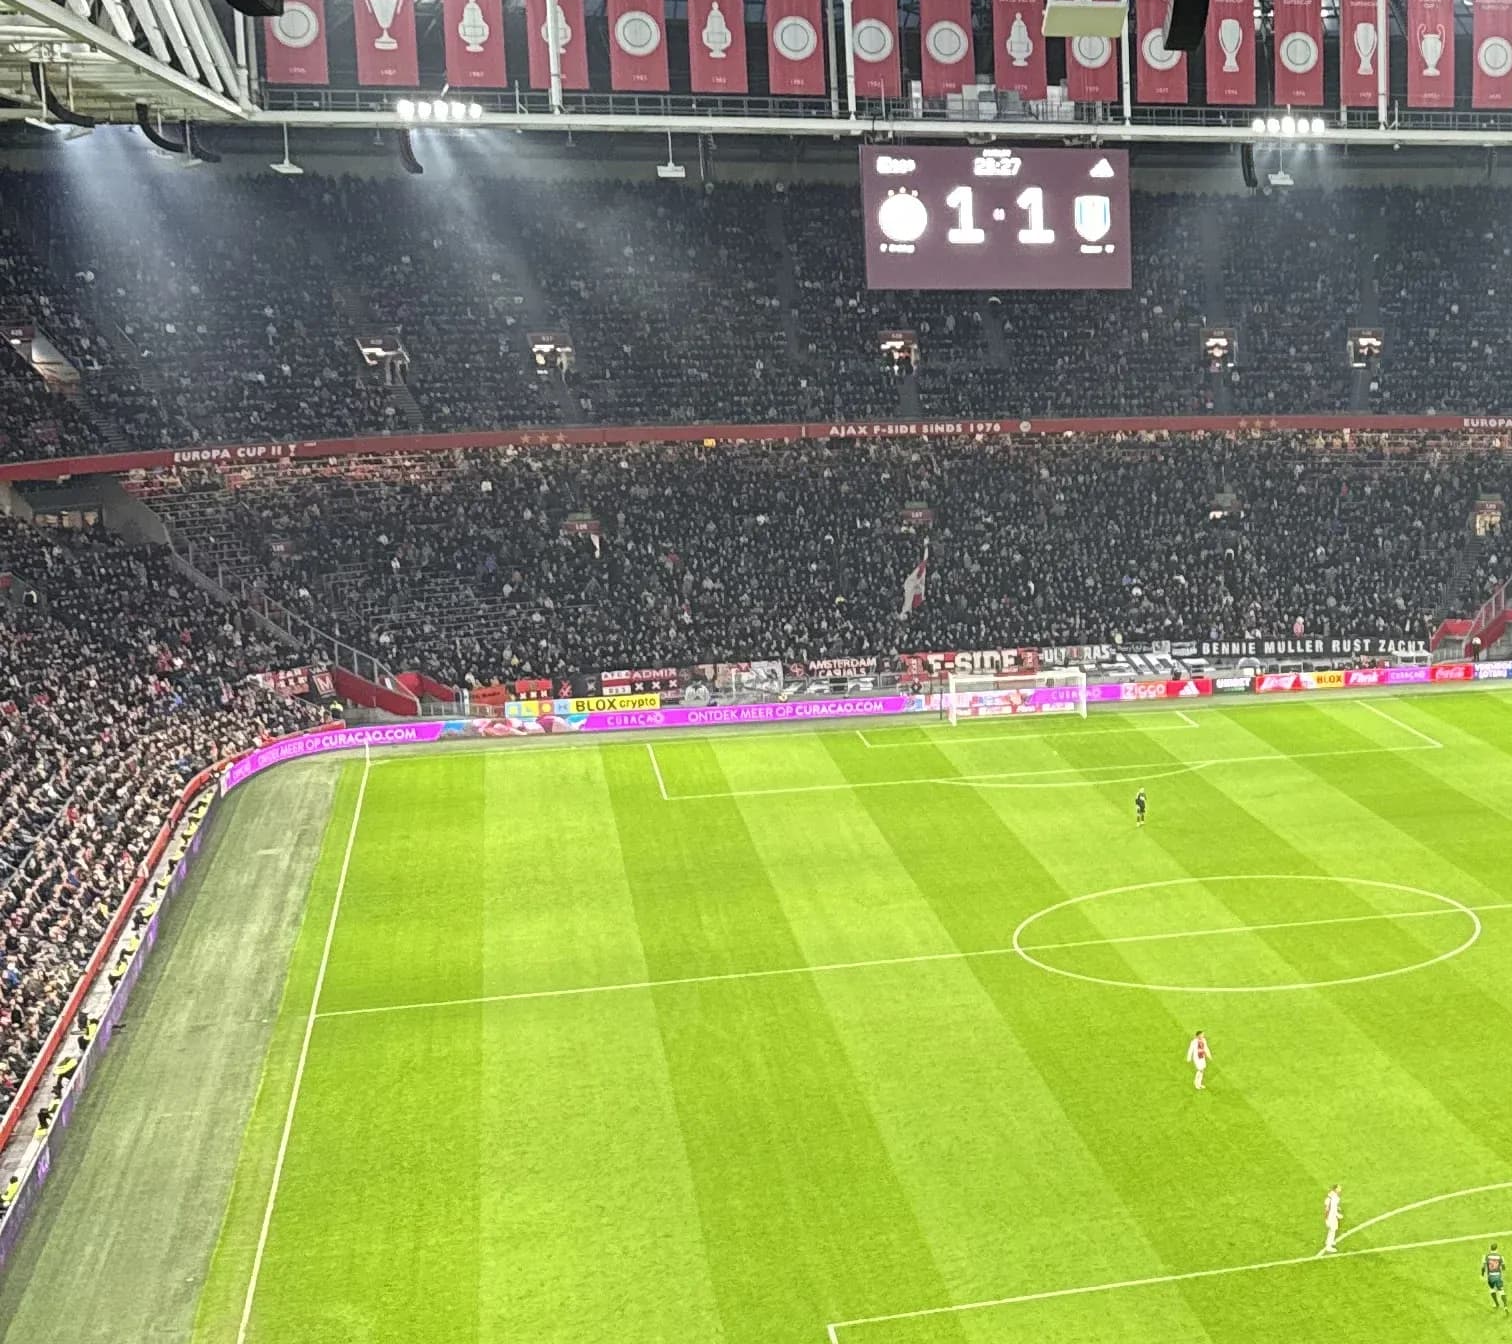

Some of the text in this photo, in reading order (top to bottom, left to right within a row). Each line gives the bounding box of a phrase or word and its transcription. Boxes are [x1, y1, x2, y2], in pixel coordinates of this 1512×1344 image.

[946, 186, 1055, 244] 1 1
[829, 422, 1001, 437] AJAX F-SIDE SINDS 1976
[173, 447, 231, 463] EUROPA
[236, 446, 267, 461] CUP
[1202, 641, 1256, 655] BENNIE
[1264, 639, 1324, 655] MULLER
[1331, 638, 1369, 654] RUST
[809, 657, 877, 670] AMSTERDAM
[576, 697, 657, 712] BLOX crypto
[688, 709, 738, 723] ONTDEK
[740, 707, 773, 719] MEER
[777, 706, 793, 718] OP
